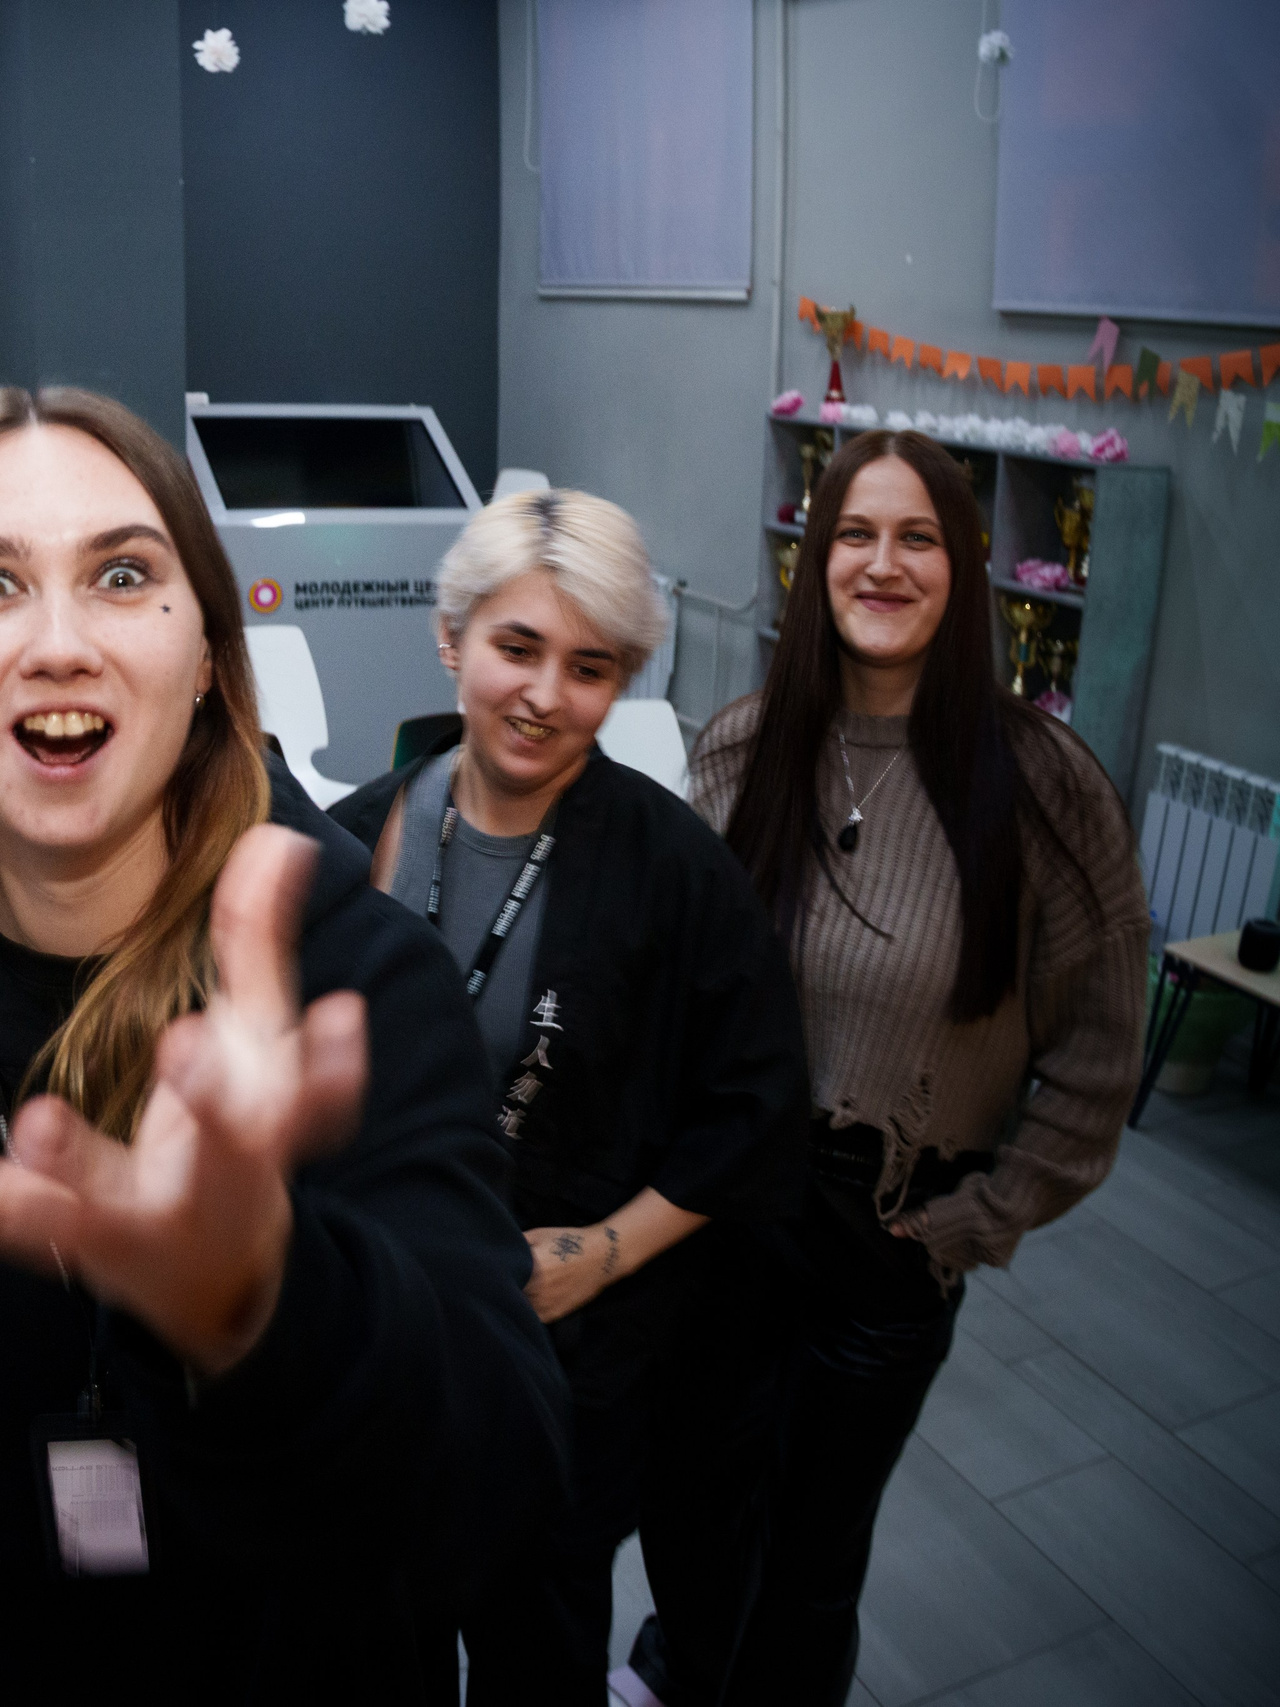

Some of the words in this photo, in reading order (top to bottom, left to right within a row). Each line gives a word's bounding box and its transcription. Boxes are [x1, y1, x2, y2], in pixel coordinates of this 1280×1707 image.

[294, 579, 409, 597] МОЛОДЕЖНЫЙ
[530, 834, 556, 862] ОЧЕНЬ
[511, 862, 541, 899] ВАЖНАЯ
[491, 898, 522, 937] ПЕРСОНА
